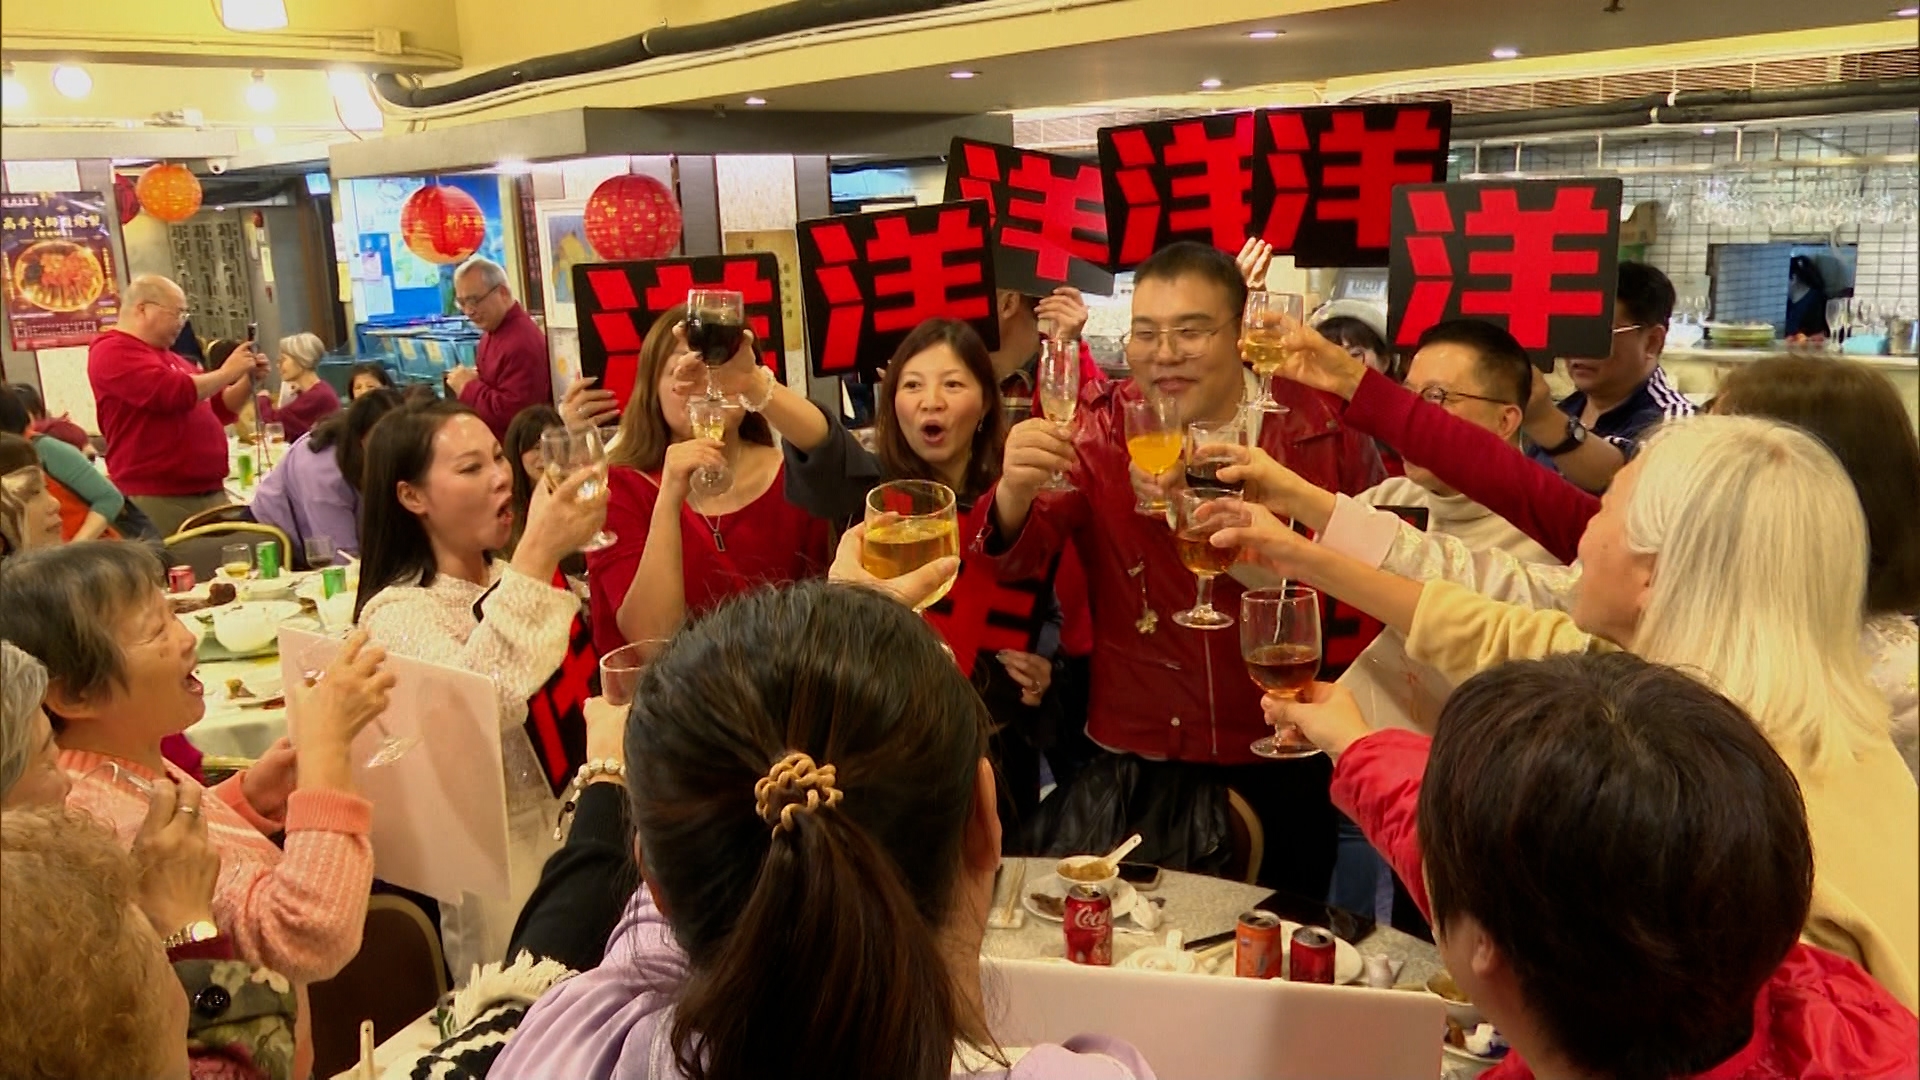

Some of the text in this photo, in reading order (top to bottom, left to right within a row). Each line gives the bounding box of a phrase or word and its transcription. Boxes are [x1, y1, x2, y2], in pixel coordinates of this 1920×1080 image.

[960, 144, 1109, 282] 洋
[1111, 112, 1255, 264] 洋
[1262, 107, 1439, 250] 洋
[810, 208, 990, 370] 洋
[1395, 186, 1609, 349] 洋
